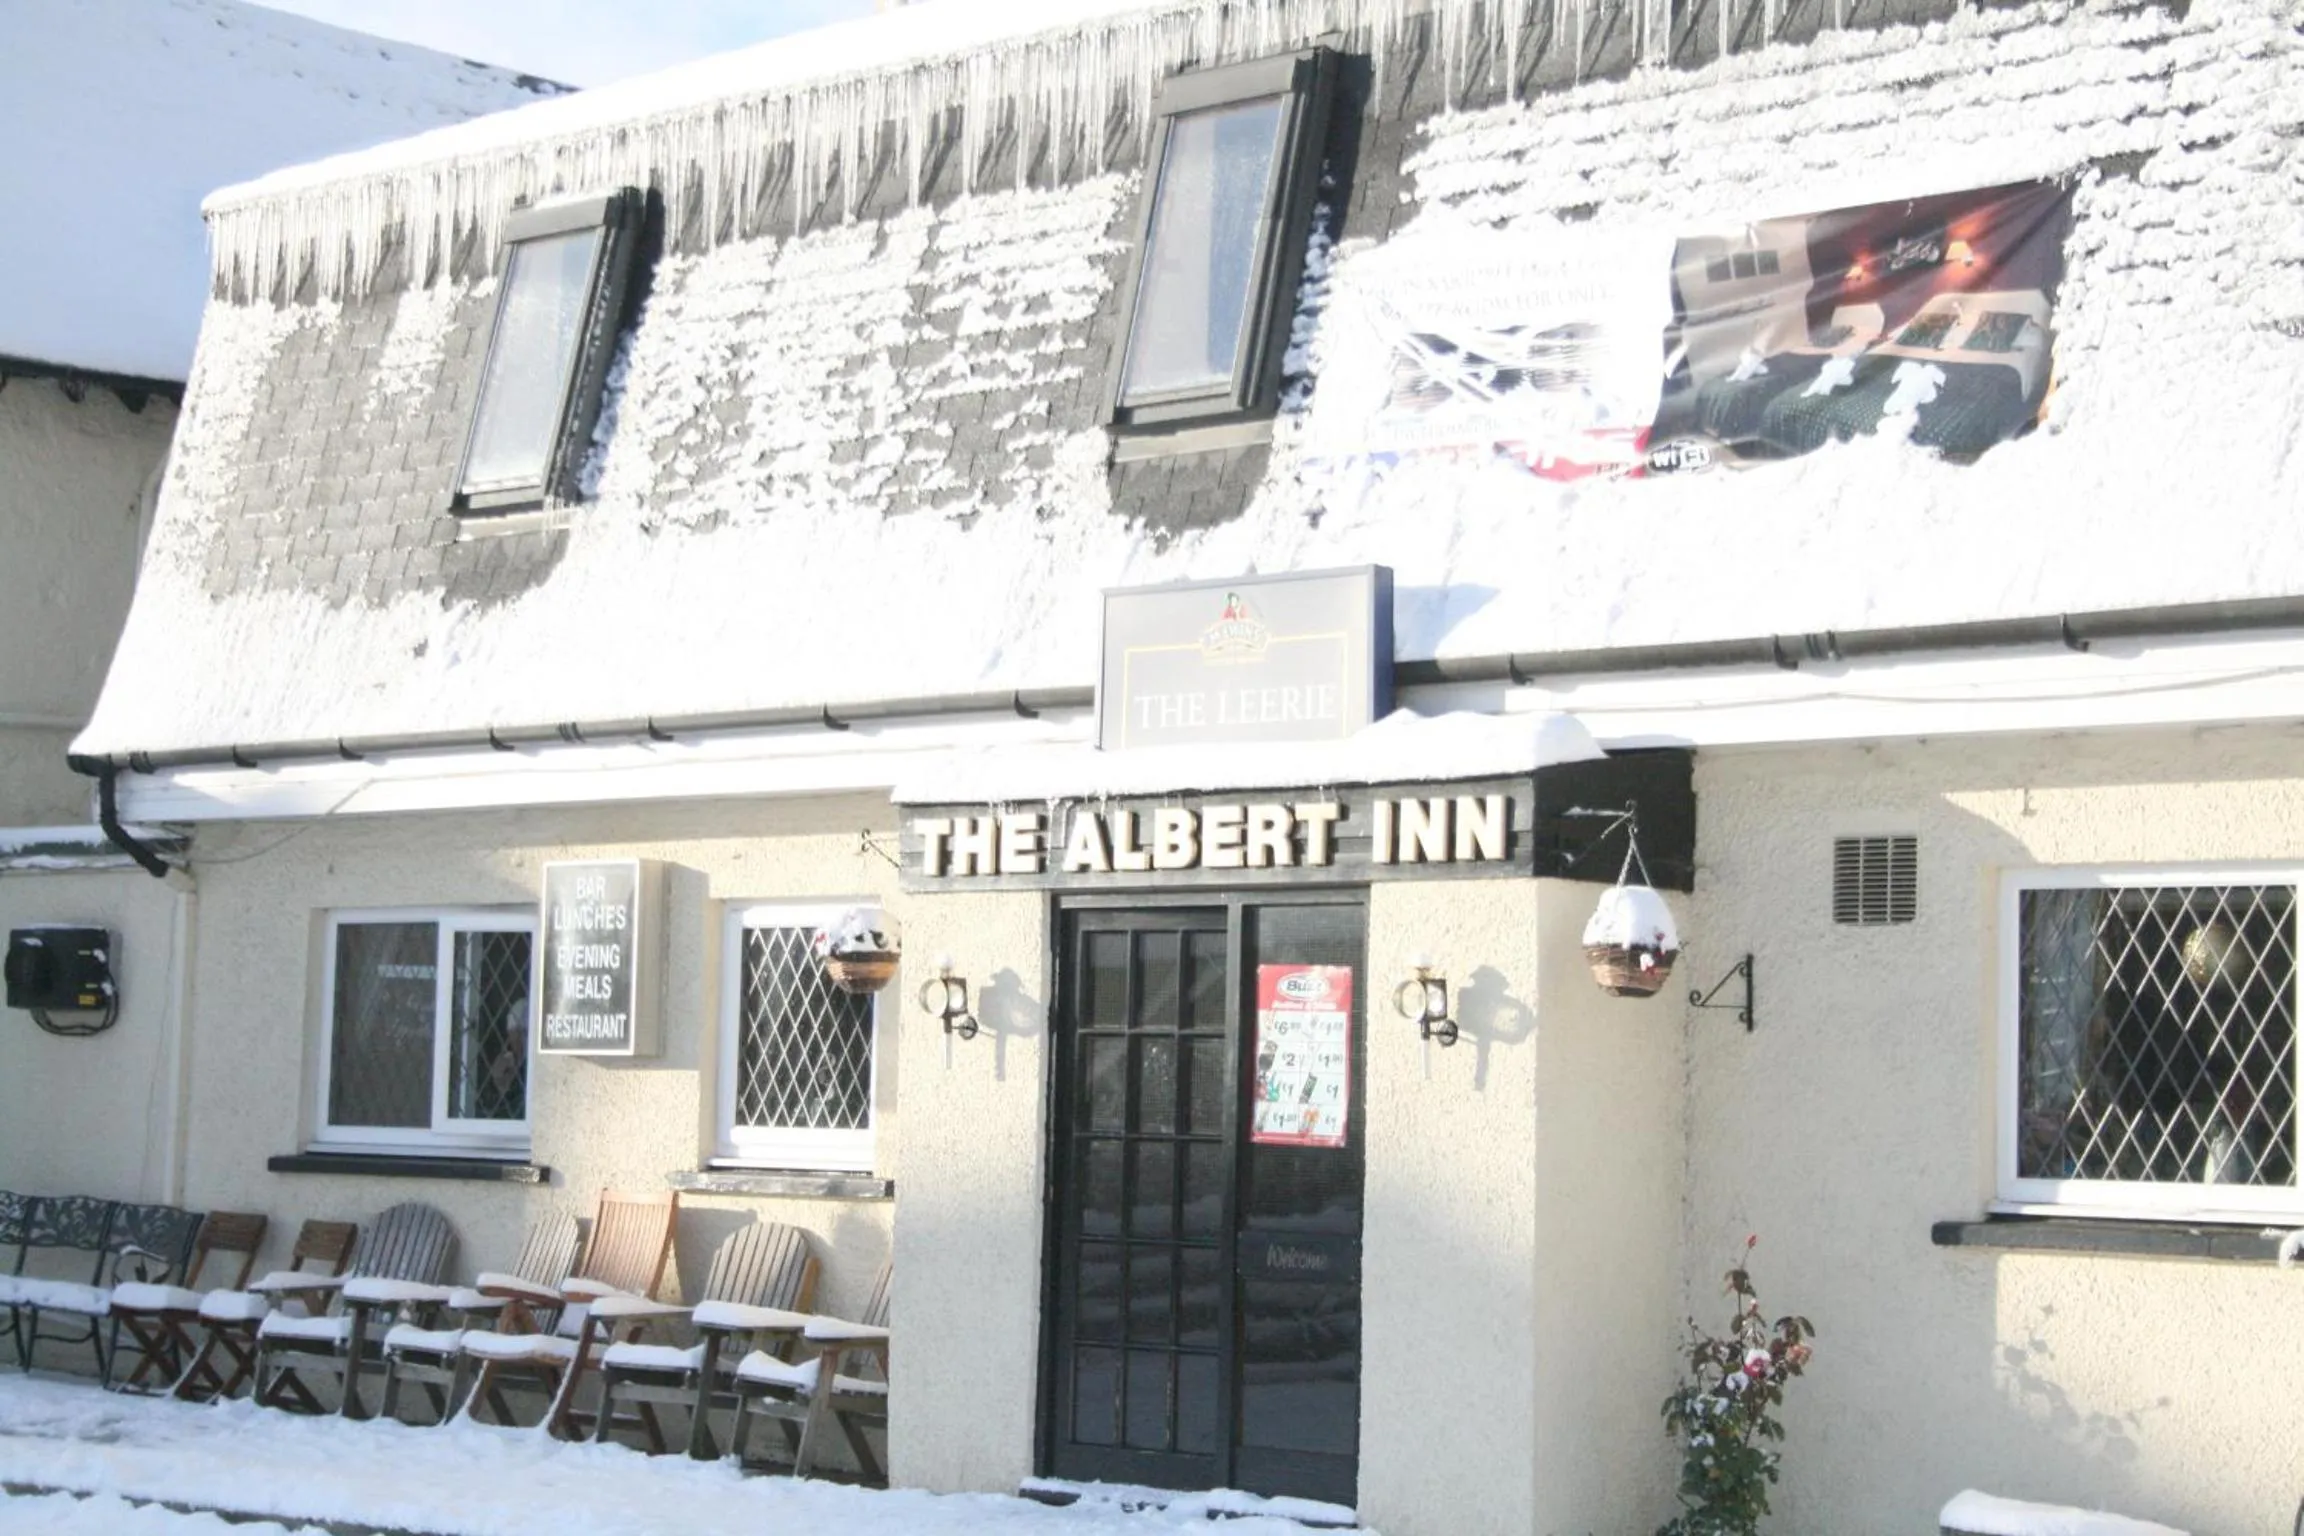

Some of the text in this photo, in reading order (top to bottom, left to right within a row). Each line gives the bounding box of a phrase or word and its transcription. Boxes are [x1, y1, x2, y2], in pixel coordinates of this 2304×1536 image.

[1134, 683, 1337, 730] THE LEERIE
[913, 794, 1510, 877] THE ALBERT INN
[576, 875, 606, 900] BAR
[553, 904, 627, 931] LUNCHES
[557, 943, 621, 970] EVENING
[562, 974, 612, 1000] MEALS
[546, 1012, 627, 1039] RESTAURANT
